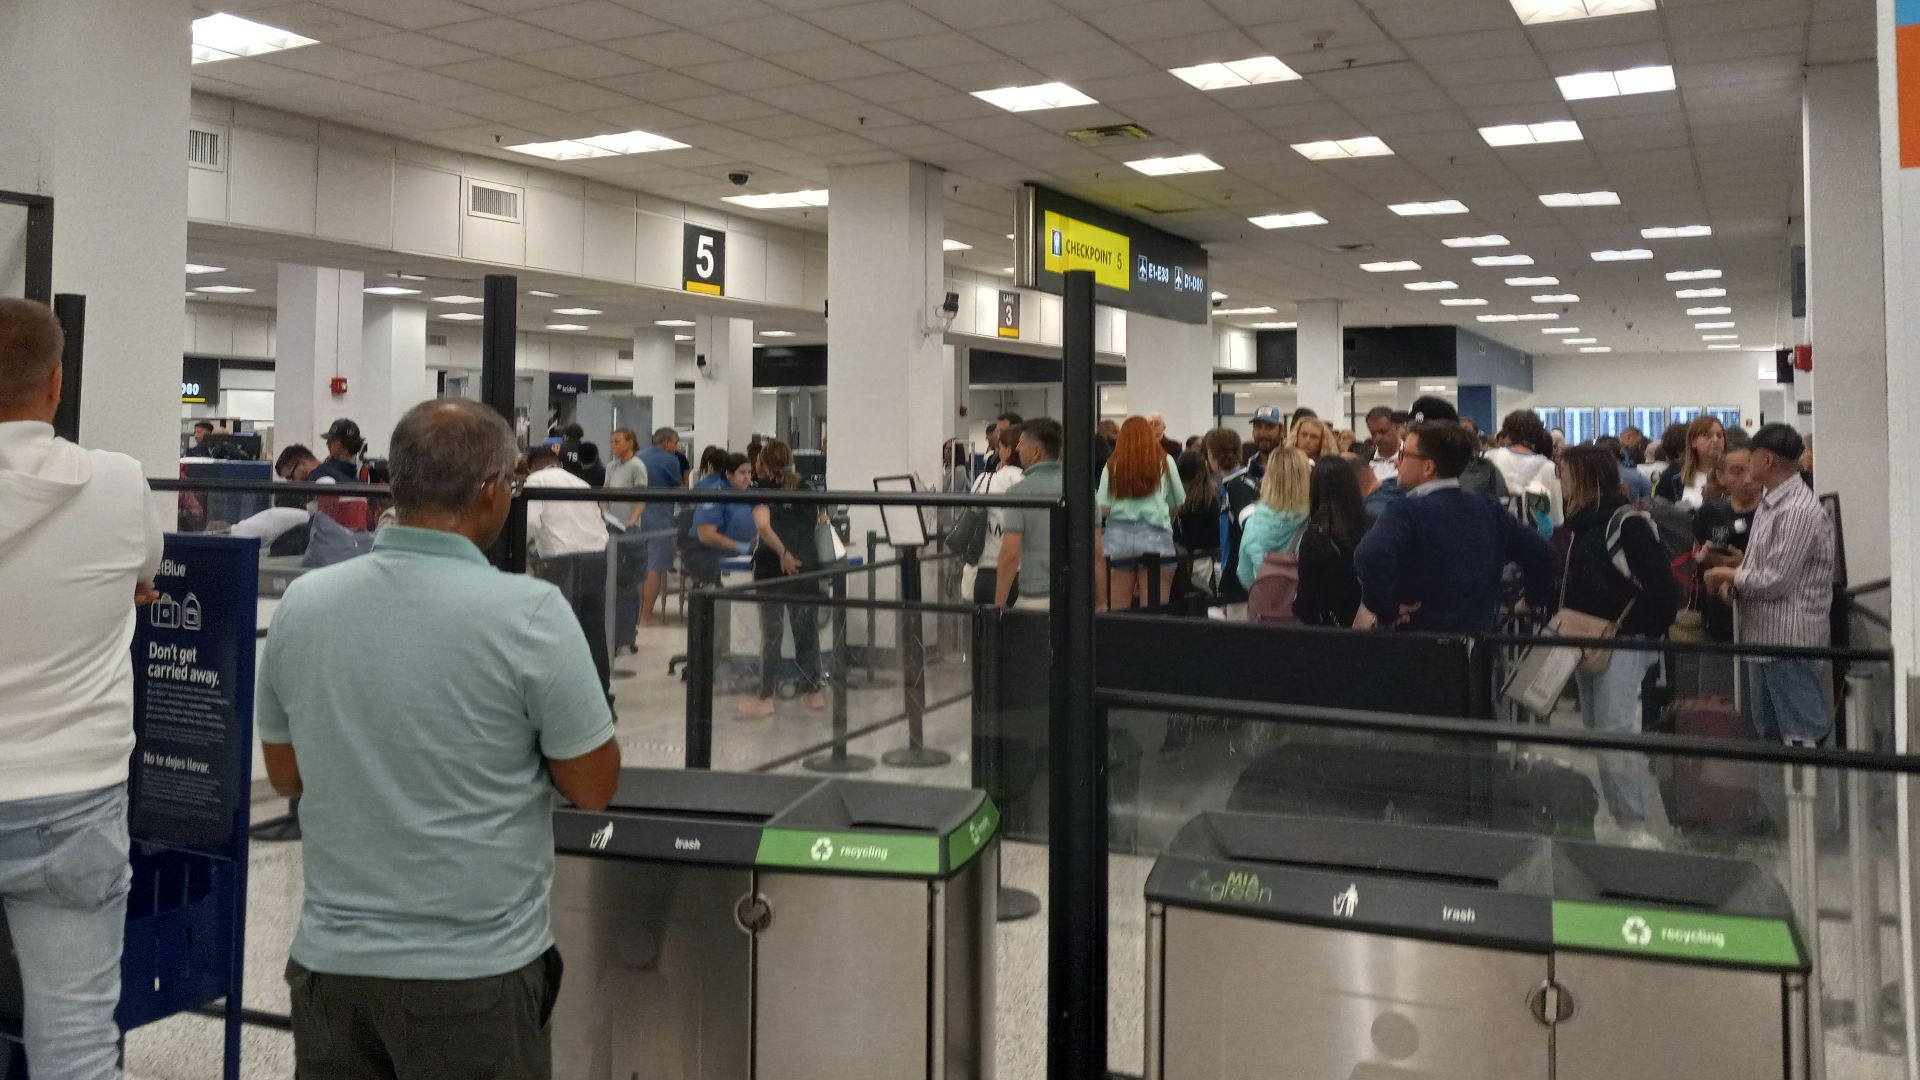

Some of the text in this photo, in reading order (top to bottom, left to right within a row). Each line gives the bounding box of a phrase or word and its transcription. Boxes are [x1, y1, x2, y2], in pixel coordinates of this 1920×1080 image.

[695, 234, 715, 279] 5
[1065, 239, 1123, 271] CHECKPOINT 5
[1005, 304, 1013, 327] 3
[157, 559, 186, 577] tBlue
[148, 641, 198, 666] Don't get
[147, 663, 220, 688] carried away.
[143, 750, 155, 765] No
[674, 836, 701, 851] trash
[839, 844, 889, 862] recycling
[1225, 871, 1260, 887] MIA
[1442, 904, 1476, 923] trash
[1661, 927, 1725, 948] recycling
